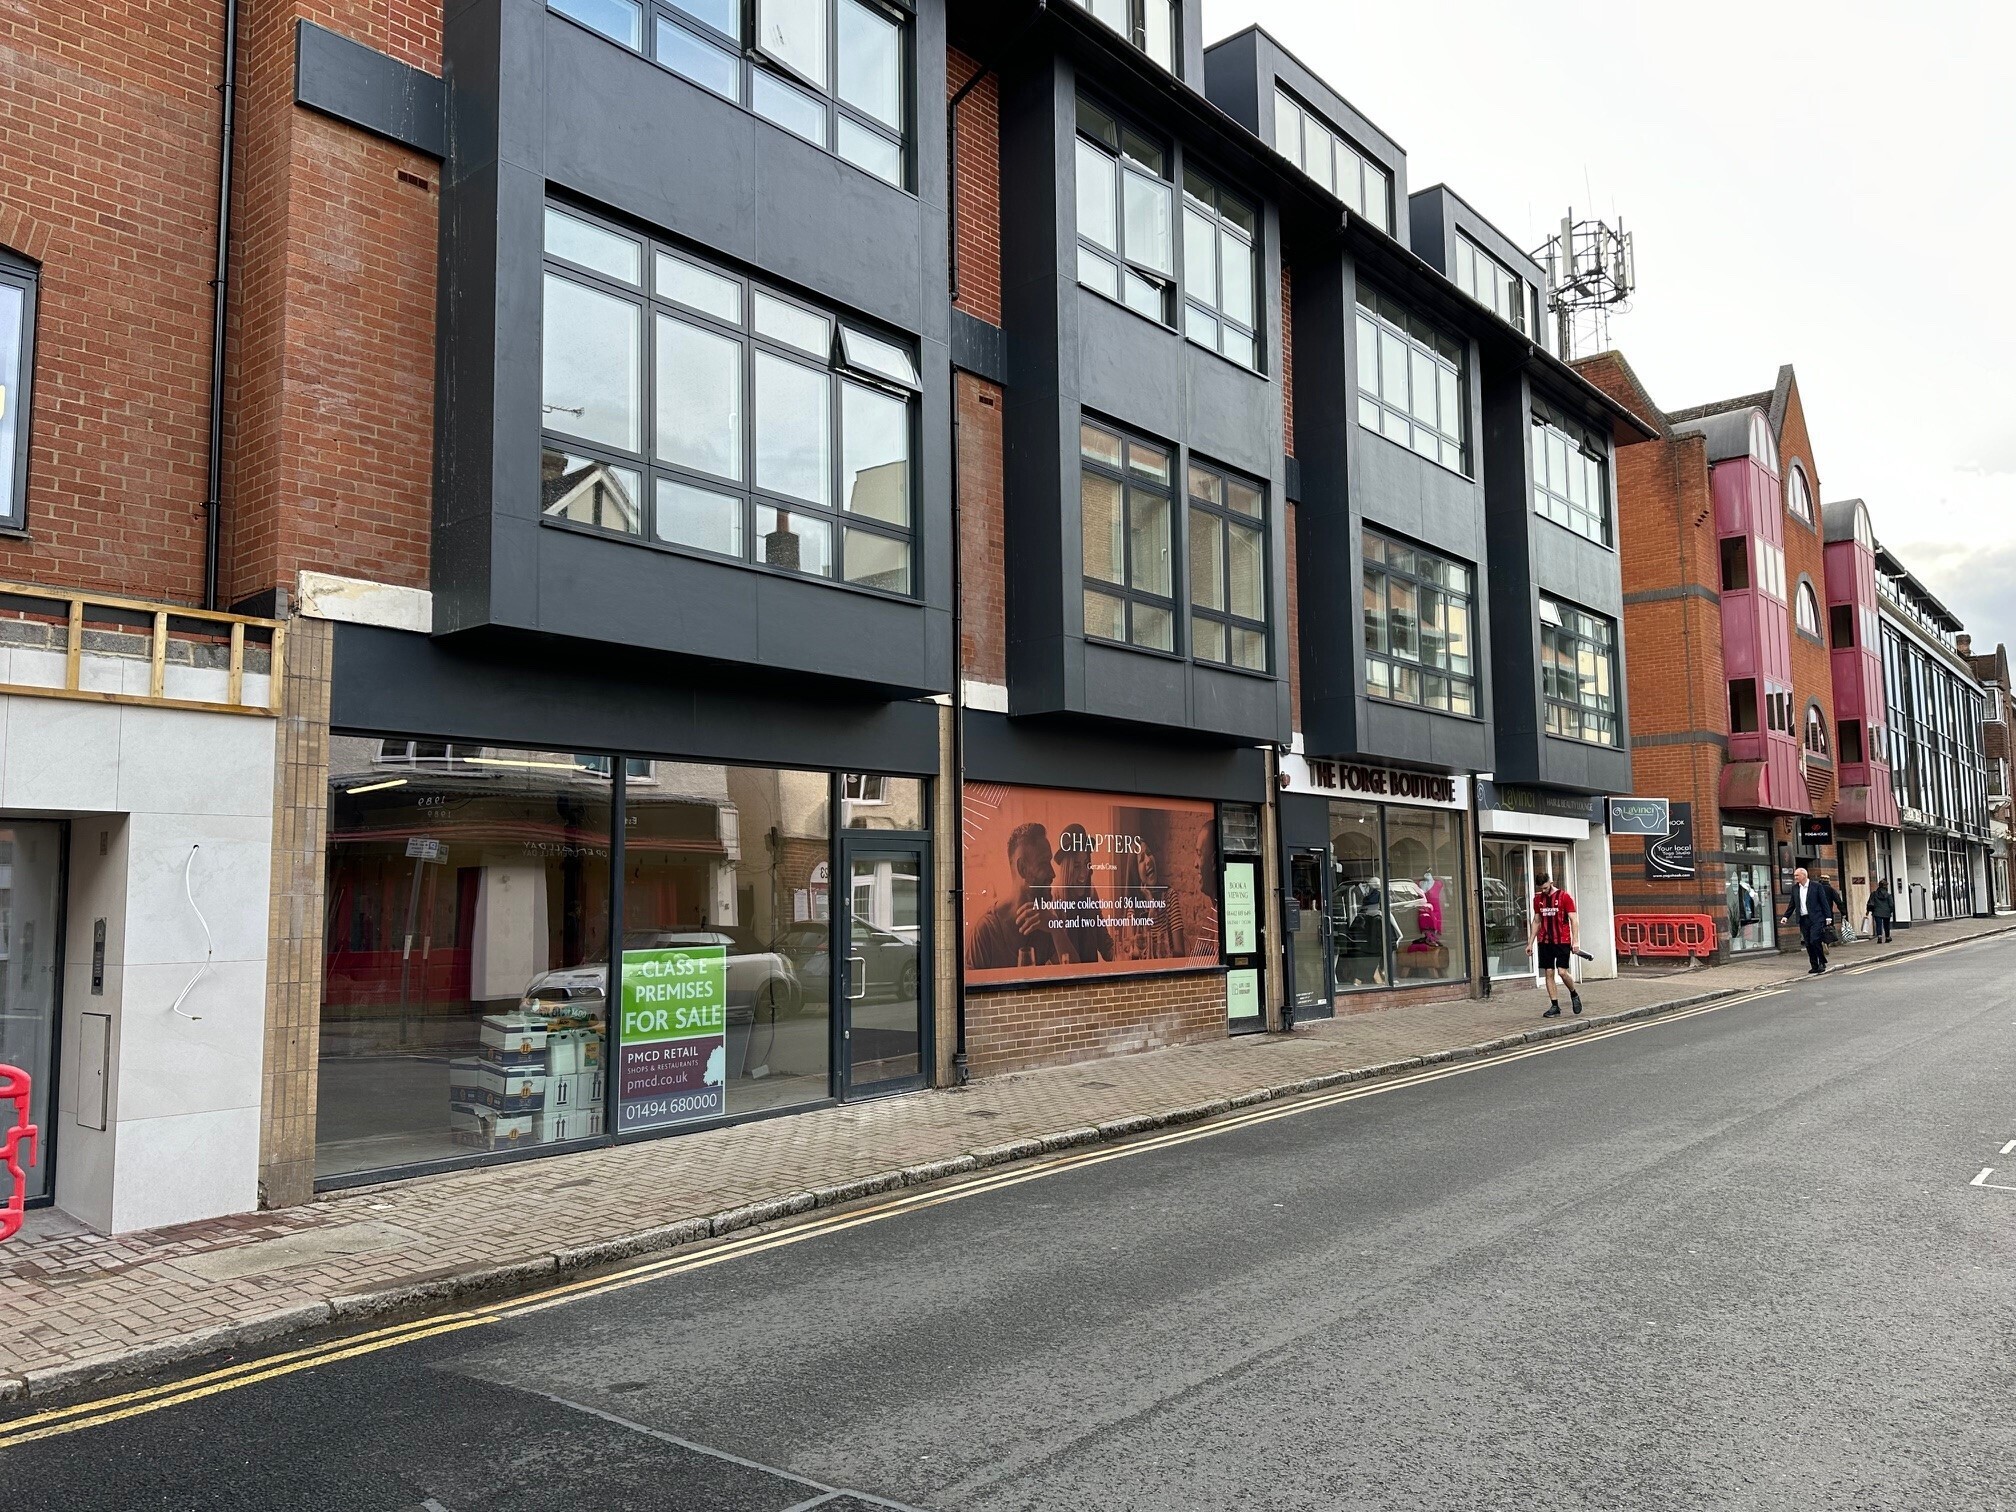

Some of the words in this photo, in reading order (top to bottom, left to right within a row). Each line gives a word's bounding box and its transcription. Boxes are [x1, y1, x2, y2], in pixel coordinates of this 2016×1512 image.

[1307, 759, 1337, 788] THE
[1339, 764, 1387, 794] FORGE
[1389, 772, 1456, 802] BOUTIQUE
[1060, 832, 1142, 854] CHAPTERS
[1032, 897, 1039, 910] A
[1041, 897, 1076, 912] boutique
[1077, 897, 1113, 910] collection
[1115, 897, 1123, 909] of
[1124, 897, 1133, 909] 36
[1134, 897, 1166, 909] luxurious
[1048, 919, 1063, 929] one
[1065, 915, 1080, 928] and
[1081, 918, 1095, 928] two
[1096, 915, 1130, 927] bedroom
[1131, 915, 1154, 926] homes
[642, 960, 694, 978] CLASS
[700, 960, 707, 974] E
[635, 980, 714, 1003] PREMISES
[625, 1009, 669, 1034] FOR
[675, 1004, 721, 1029] SALE
[628, 1050, 660, 1064] PMCD
[664, 1046, 698, 1059] RETAIL
[628, 1065, 649, 1074] SHOPS
[657, 1060, 698, 1070] RESTAURANTS
[627, 1072, 688, 1093] pmcd.co.uk
[626, 1100, 667, 1120] 01494
[670, 1093, 717, 1113] 680000
